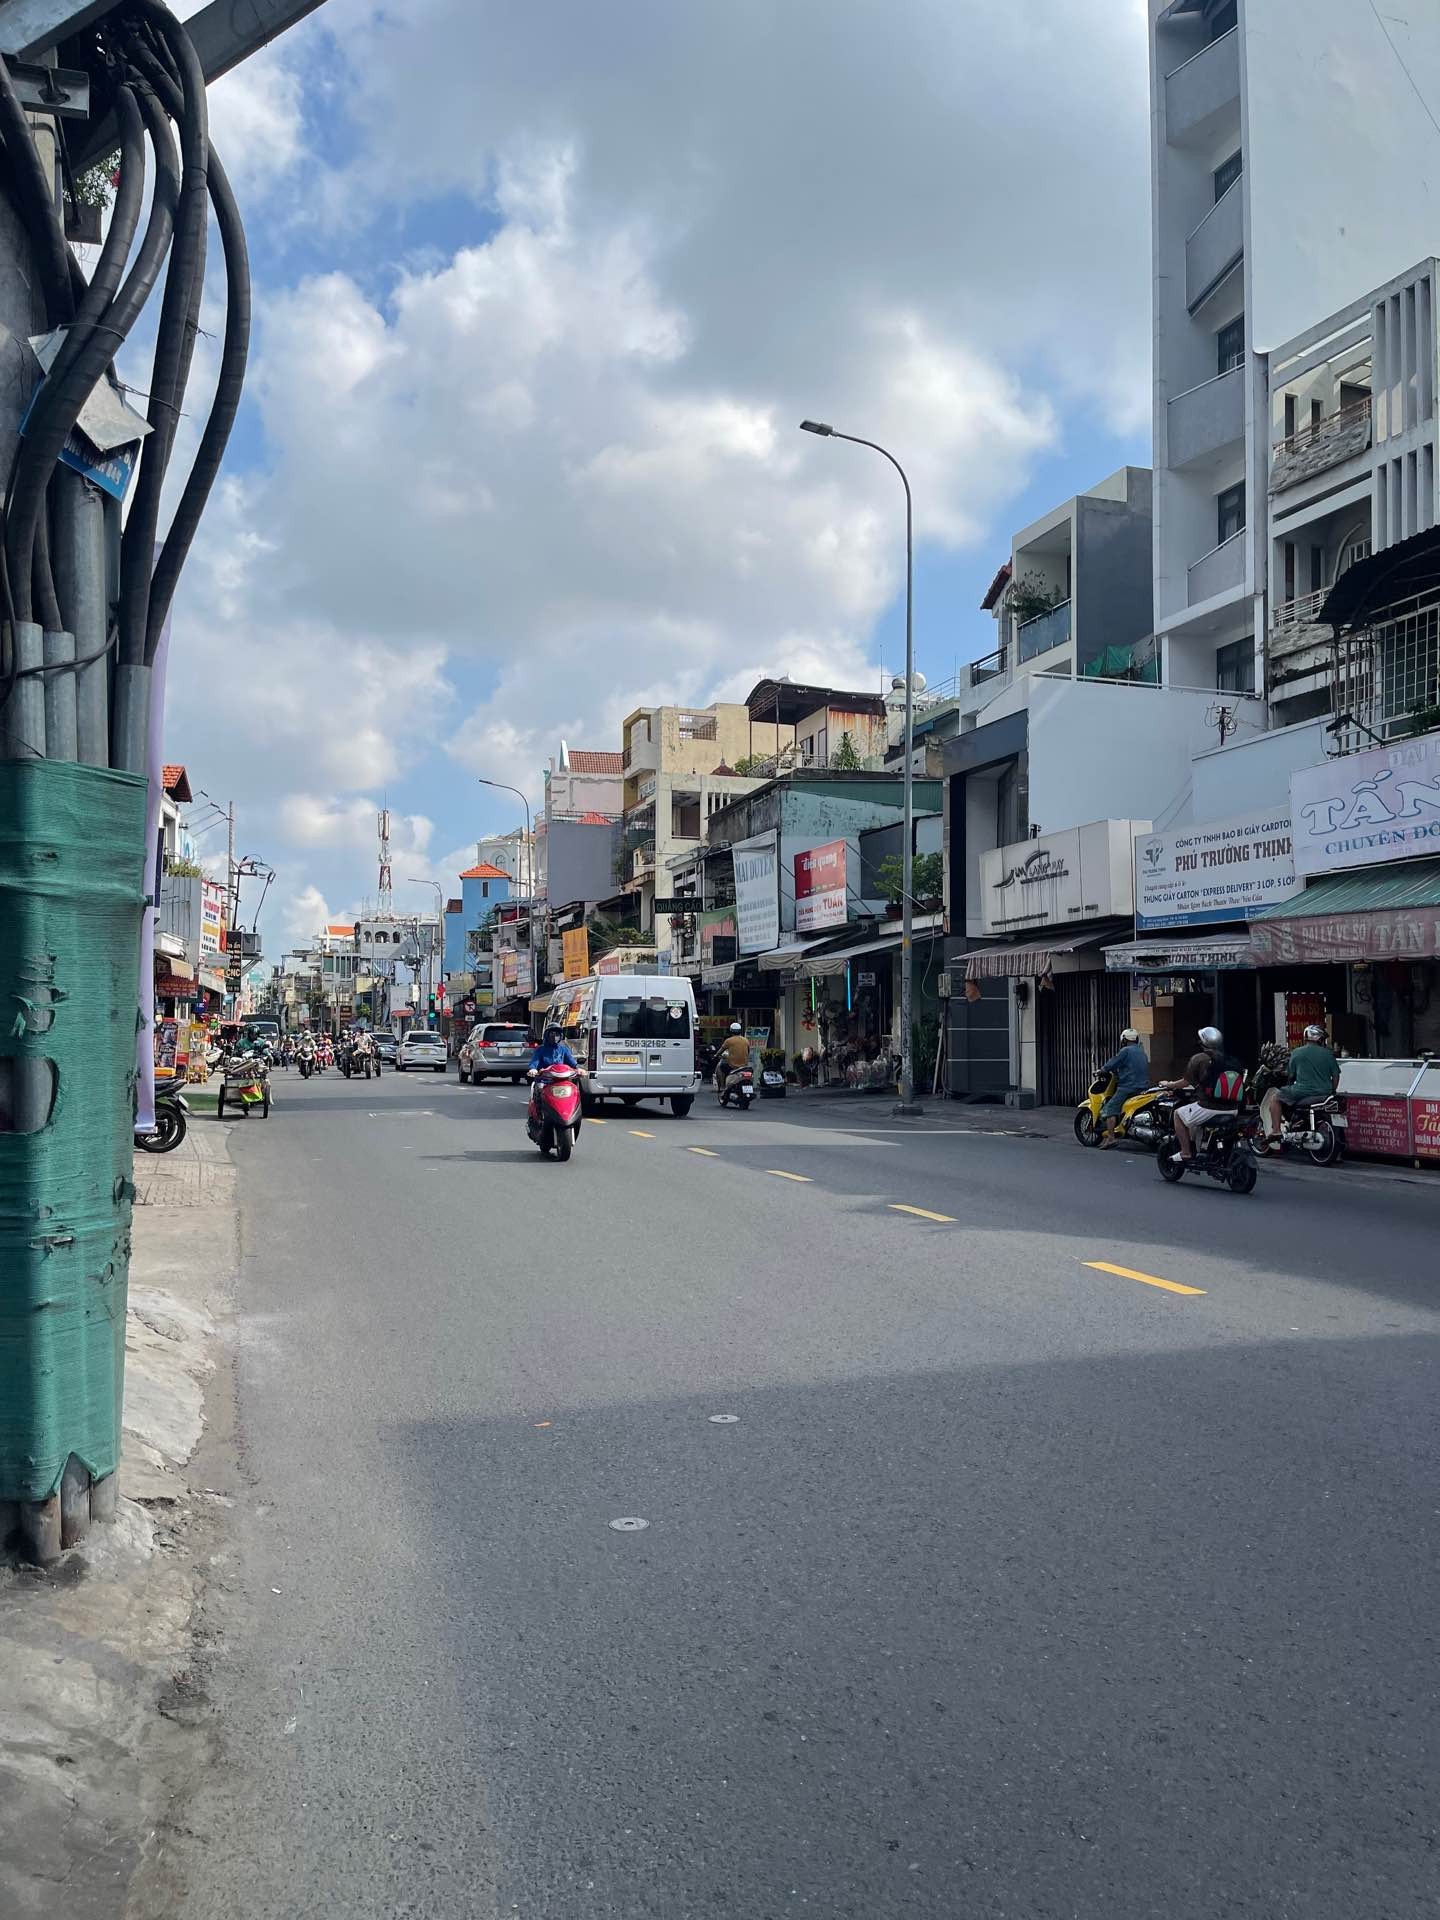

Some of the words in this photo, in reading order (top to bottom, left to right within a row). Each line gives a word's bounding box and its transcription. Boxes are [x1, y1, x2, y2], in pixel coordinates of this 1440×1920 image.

[1194, 836, 1202, 845] TY
[1203, 832, 1221, 844] TNHH
[1222, 830, 1236, 840] BAO
[1325, 827, 1406, 855] CHUYÊN
[1175, 849, 1198, 873] PHÚ
[1176, 889, 1199, 901] CARTON
